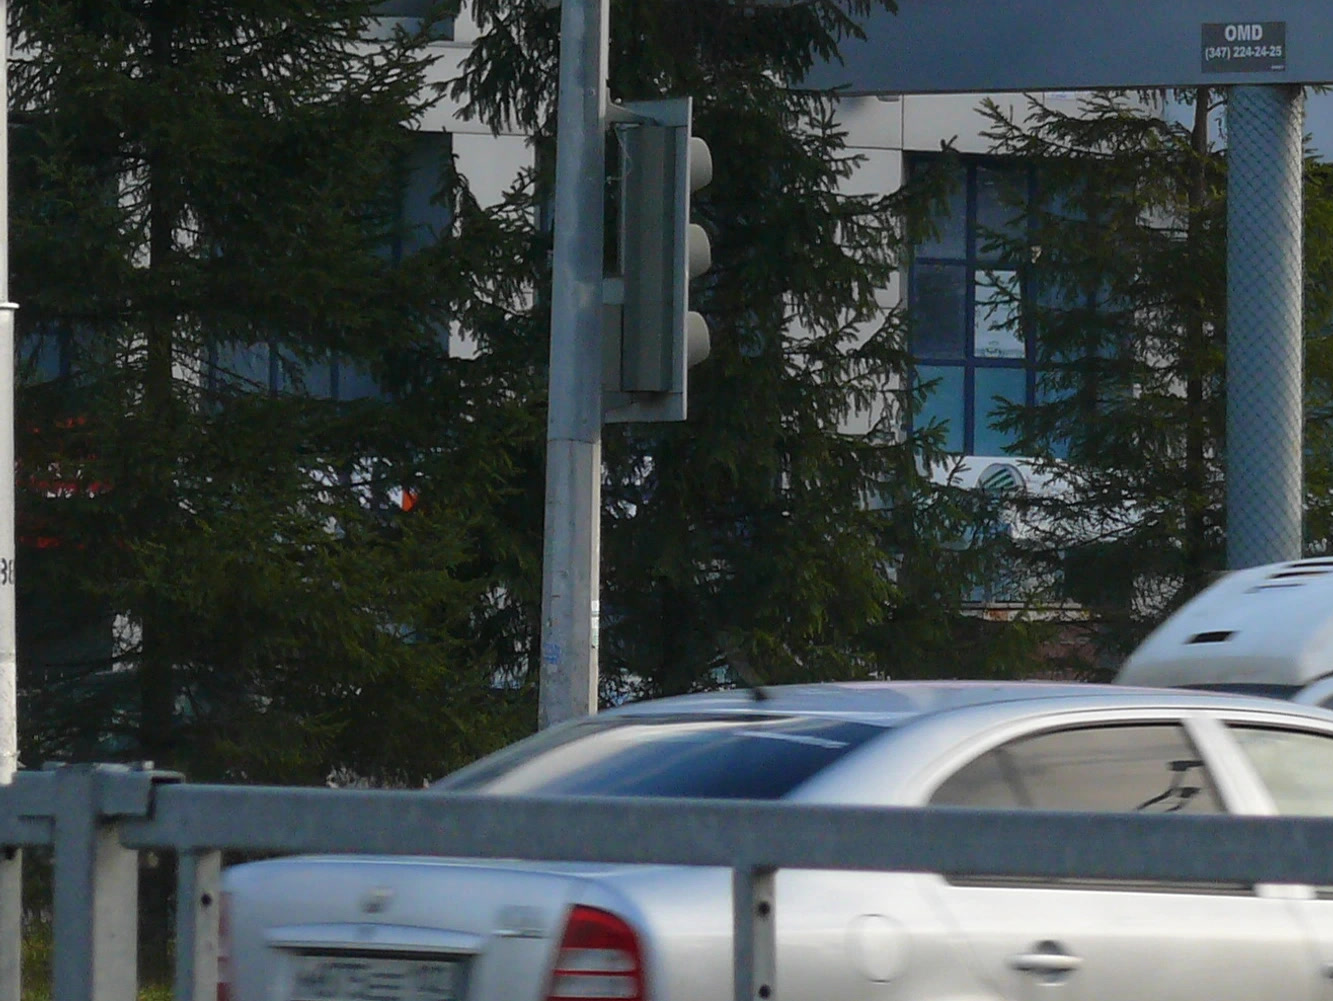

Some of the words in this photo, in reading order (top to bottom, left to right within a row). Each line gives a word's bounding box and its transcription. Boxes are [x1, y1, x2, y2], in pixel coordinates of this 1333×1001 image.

[1224, 24, 1263, 42] OMD
[1205, 46, 1232, 61] (347)
[1233, 45, 1282, 58] 224-24-25
